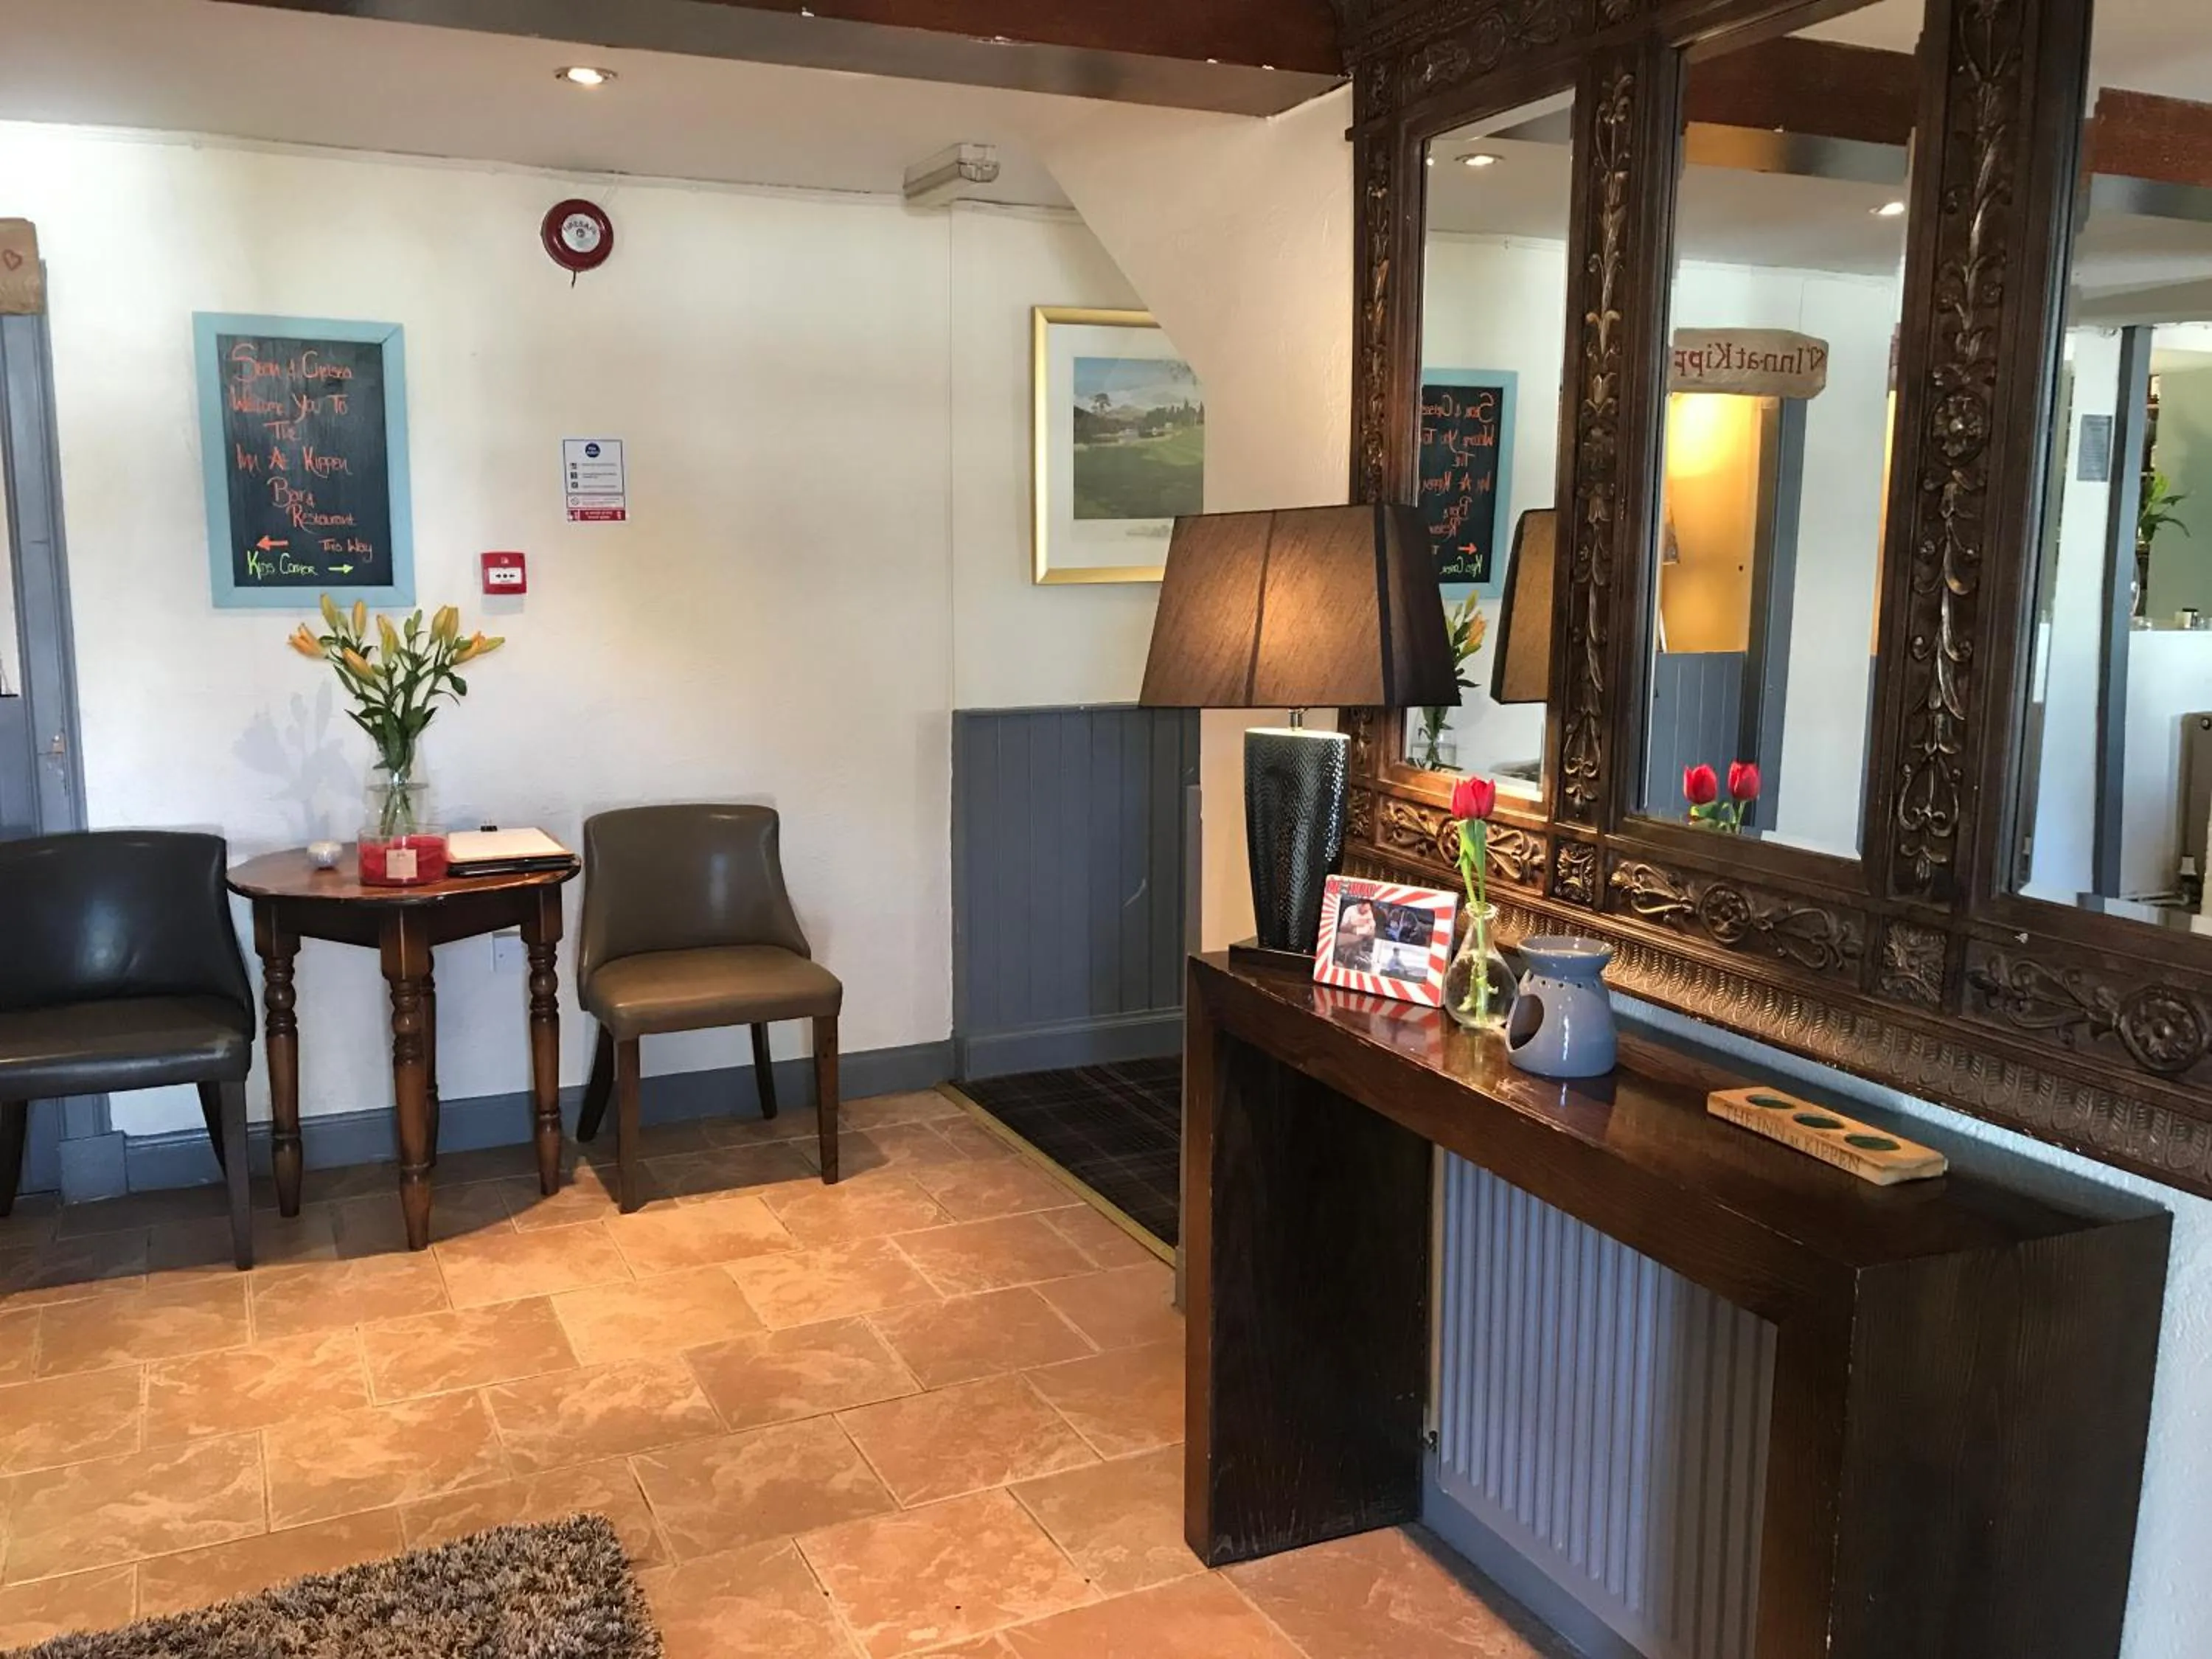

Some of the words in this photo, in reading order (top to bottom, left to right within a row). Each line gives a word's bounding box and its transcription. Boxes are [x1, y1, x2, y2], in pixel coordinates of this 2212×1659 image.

[291, 393, 321, 424] You
[327, 394, 349, 414] To
[263, 420, 301, 441] The
[302, 445, 353, 478] Kippen
[266, 476, 304, 509] Bar
[347, 538, 372, 563] Way
[1725, 1104, 1753, 1128] THE
[1757, 1115, 1786, 1141] INN
[1804, 1135, 1863, 1172] KIPPEN
